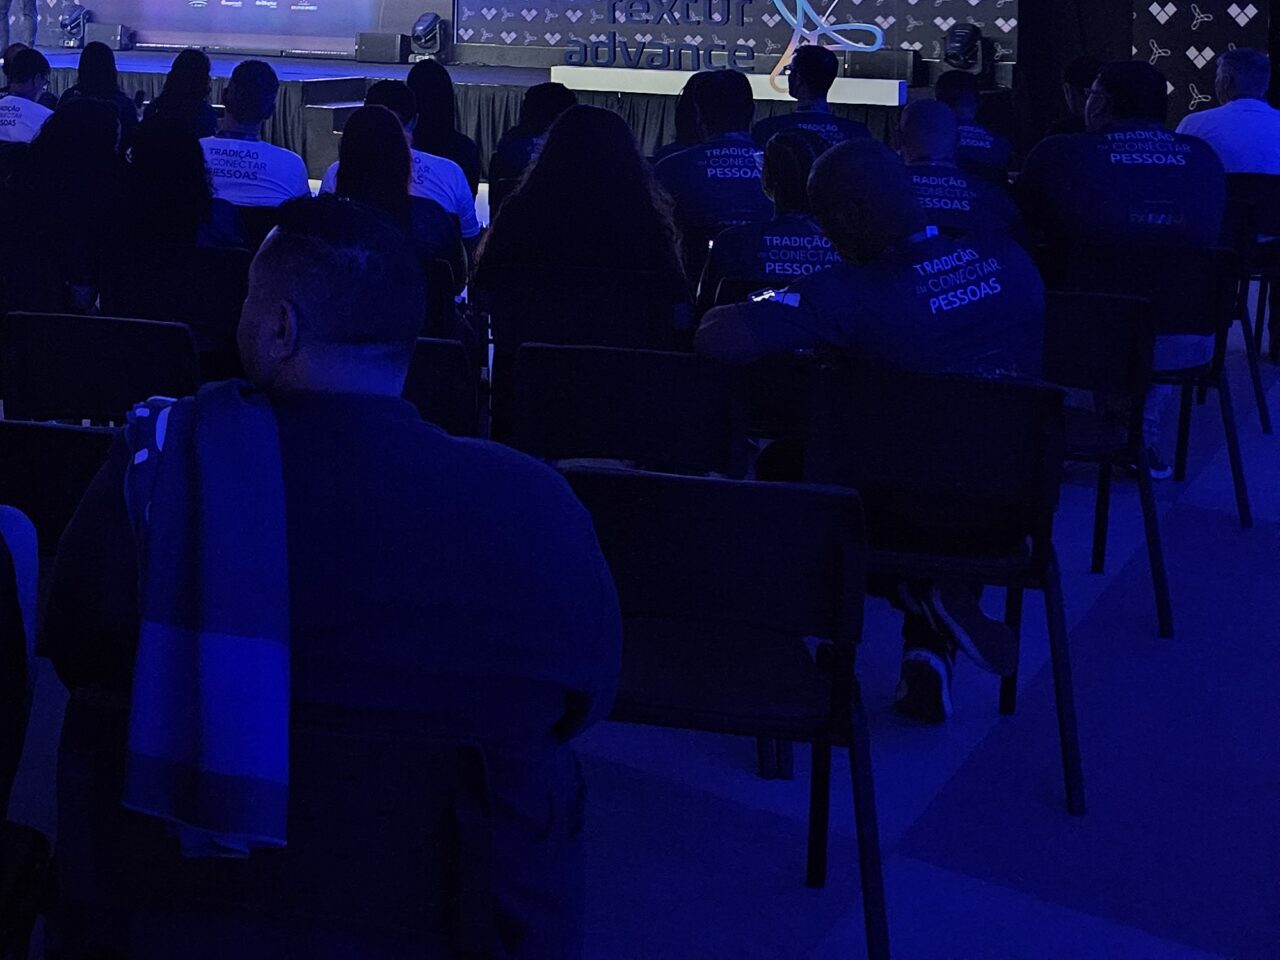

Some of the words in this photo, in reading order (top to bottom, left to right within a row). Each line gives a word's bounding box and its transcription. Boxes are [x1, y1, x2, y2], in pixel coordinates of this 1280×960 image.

[564, 31, 755, 71] advance
[1105, 130, 1175, 142] TRADIÇÃO
[209, 147, 259, 159] TRADIÇÃO
[705, 147, 755, 157] TRADIÇÃ
[1113, 142, 1192, 153] CONECTAR
[211, 159, 267, 170] CONECTAR
[709, 158, 754, 166] CONEC
[1110, 153, 1186, 165] PESSOAS
[707, 168, 761, 178] PESSOA
[913, 175, 967, 188] RADIÇÃO
[763, 235, 832, 249] TRADIÇÃO
[913, 248, 980, 276] TRADIÇÃO
[928, 257, 1002, 292] CONECTAR
[929, 277, 1001, 314] PESSOAS
